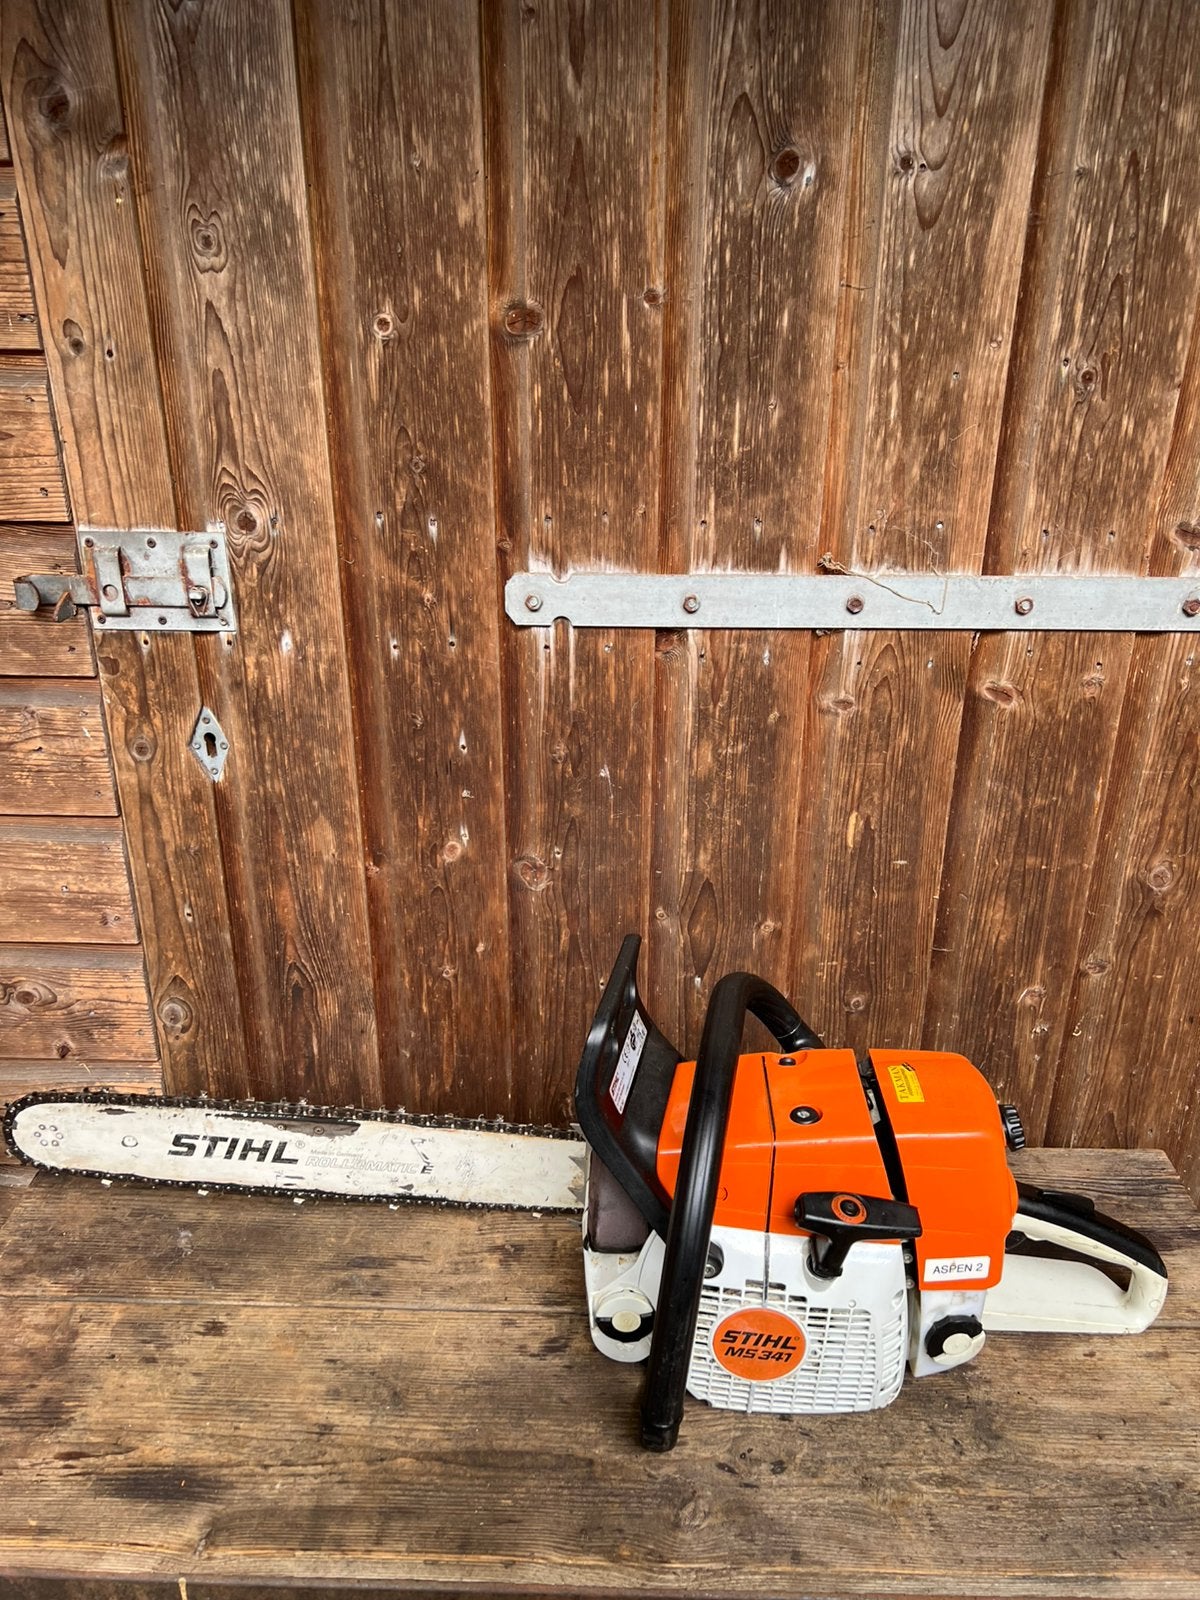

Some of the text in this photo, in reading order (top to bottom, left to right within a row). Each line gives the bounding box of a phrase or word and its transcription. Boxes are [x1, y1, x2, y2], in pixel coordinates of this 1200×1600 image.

[167, 1133, 299, 1164] STIHL
[932, 1262, 984, 1275] ASPEN 2
[720, 1329, 797, 1351] STIHL
[724, 1346, 793, 1363] MS 341
